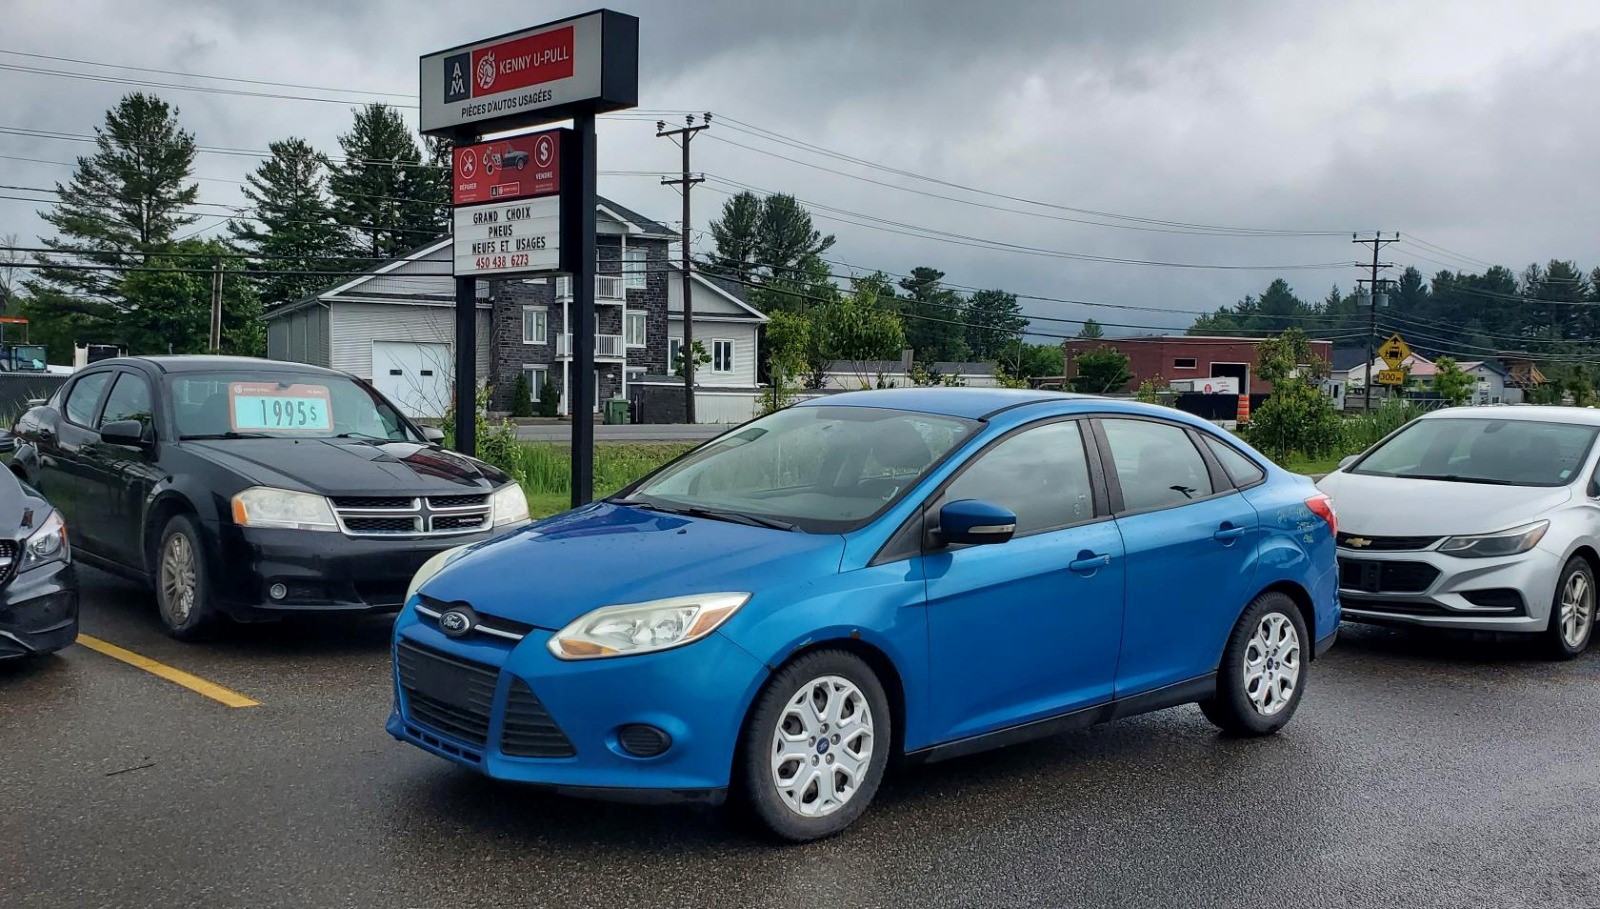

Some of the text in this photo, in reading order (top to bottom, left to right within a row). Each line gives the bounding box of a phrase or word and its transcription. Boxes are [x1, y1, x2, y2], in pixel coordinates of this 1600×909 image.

[499, 46, 570, 75] KENNY U-PULL
[461, 89, 552, 118] PIÈCES D'AUTOS USAGÉES
[473, 206, 531, 224] GRAND CHOIX
[488, 224, 513, 237] PNEUS
[472, 236, 546, 254] NEUFS ET USAGES
[476, 254, 529, 269] 450 438 6273
[1380, 372, 1395, 381] 300
[443, 614, 462, 629] Ford
